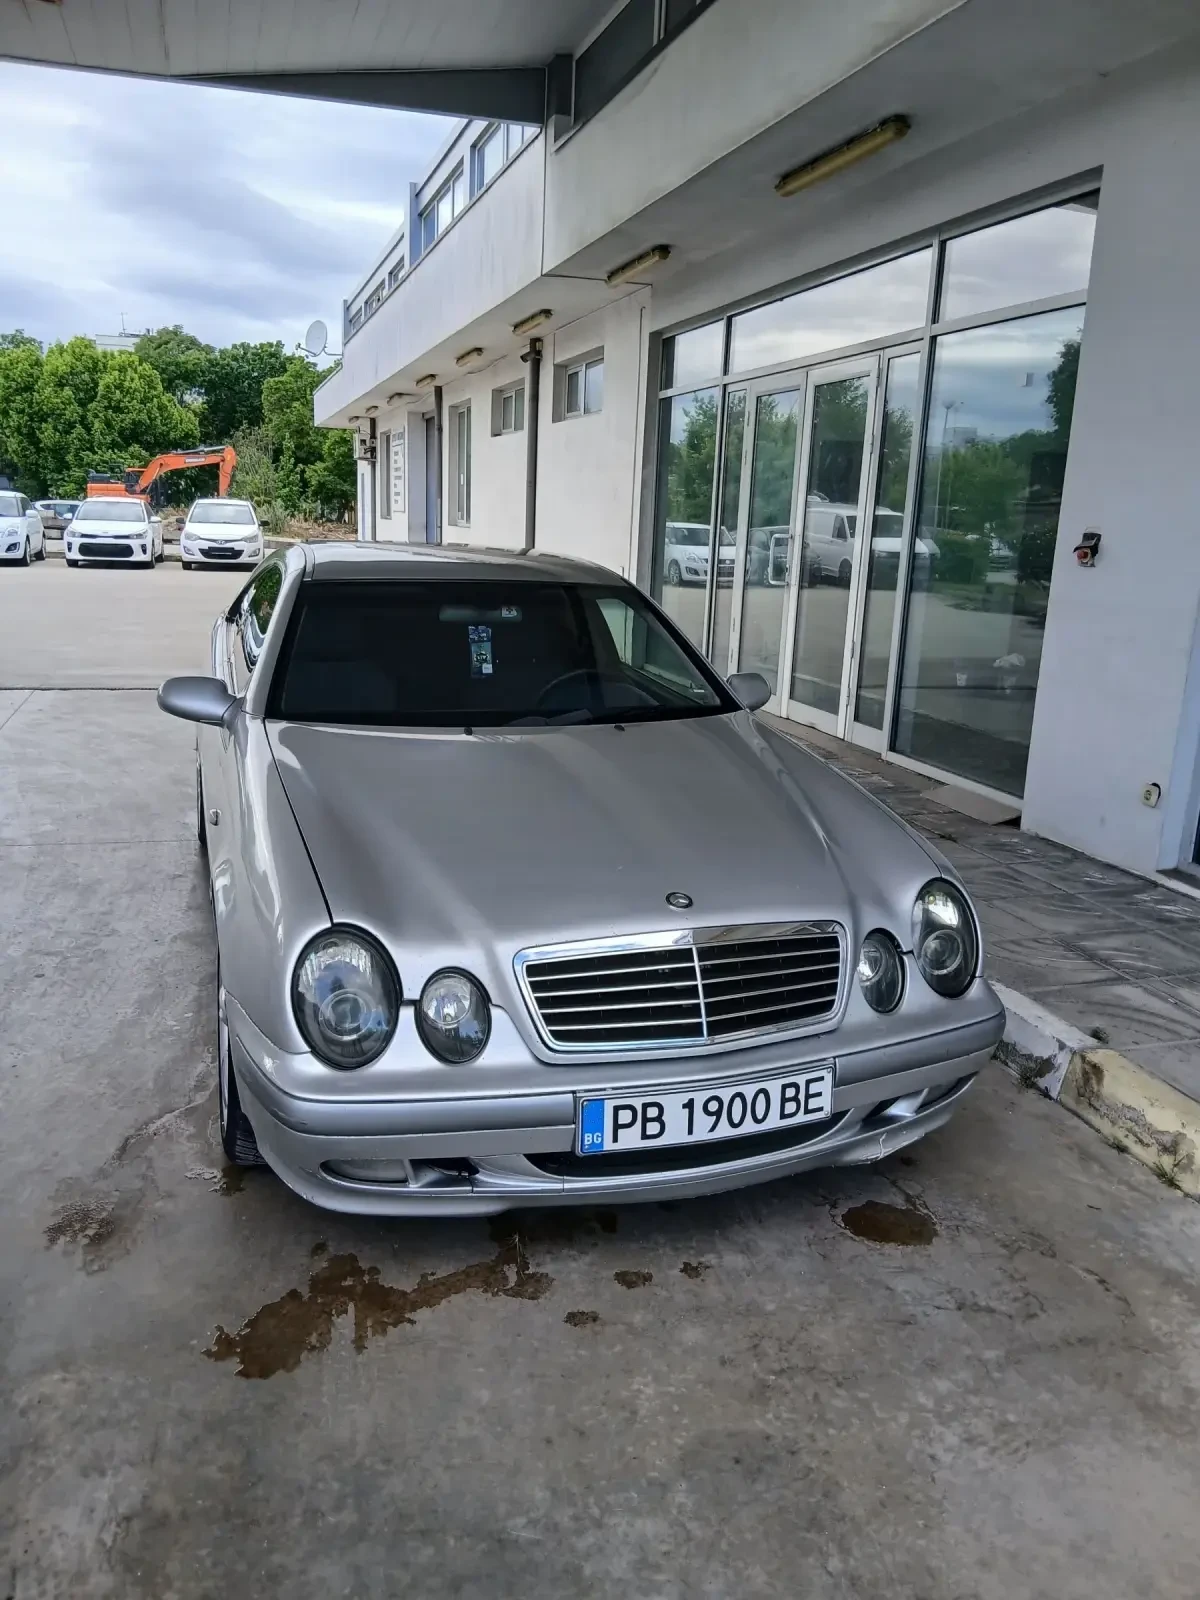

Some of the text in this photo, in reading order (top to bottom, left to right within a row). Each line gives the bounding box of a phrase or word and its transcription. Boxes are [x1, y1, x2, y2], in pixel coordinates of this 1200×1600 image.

[612, 1075, 825, 1143] PB 1900 BE
[584, 1132, 602, 1145] BG
